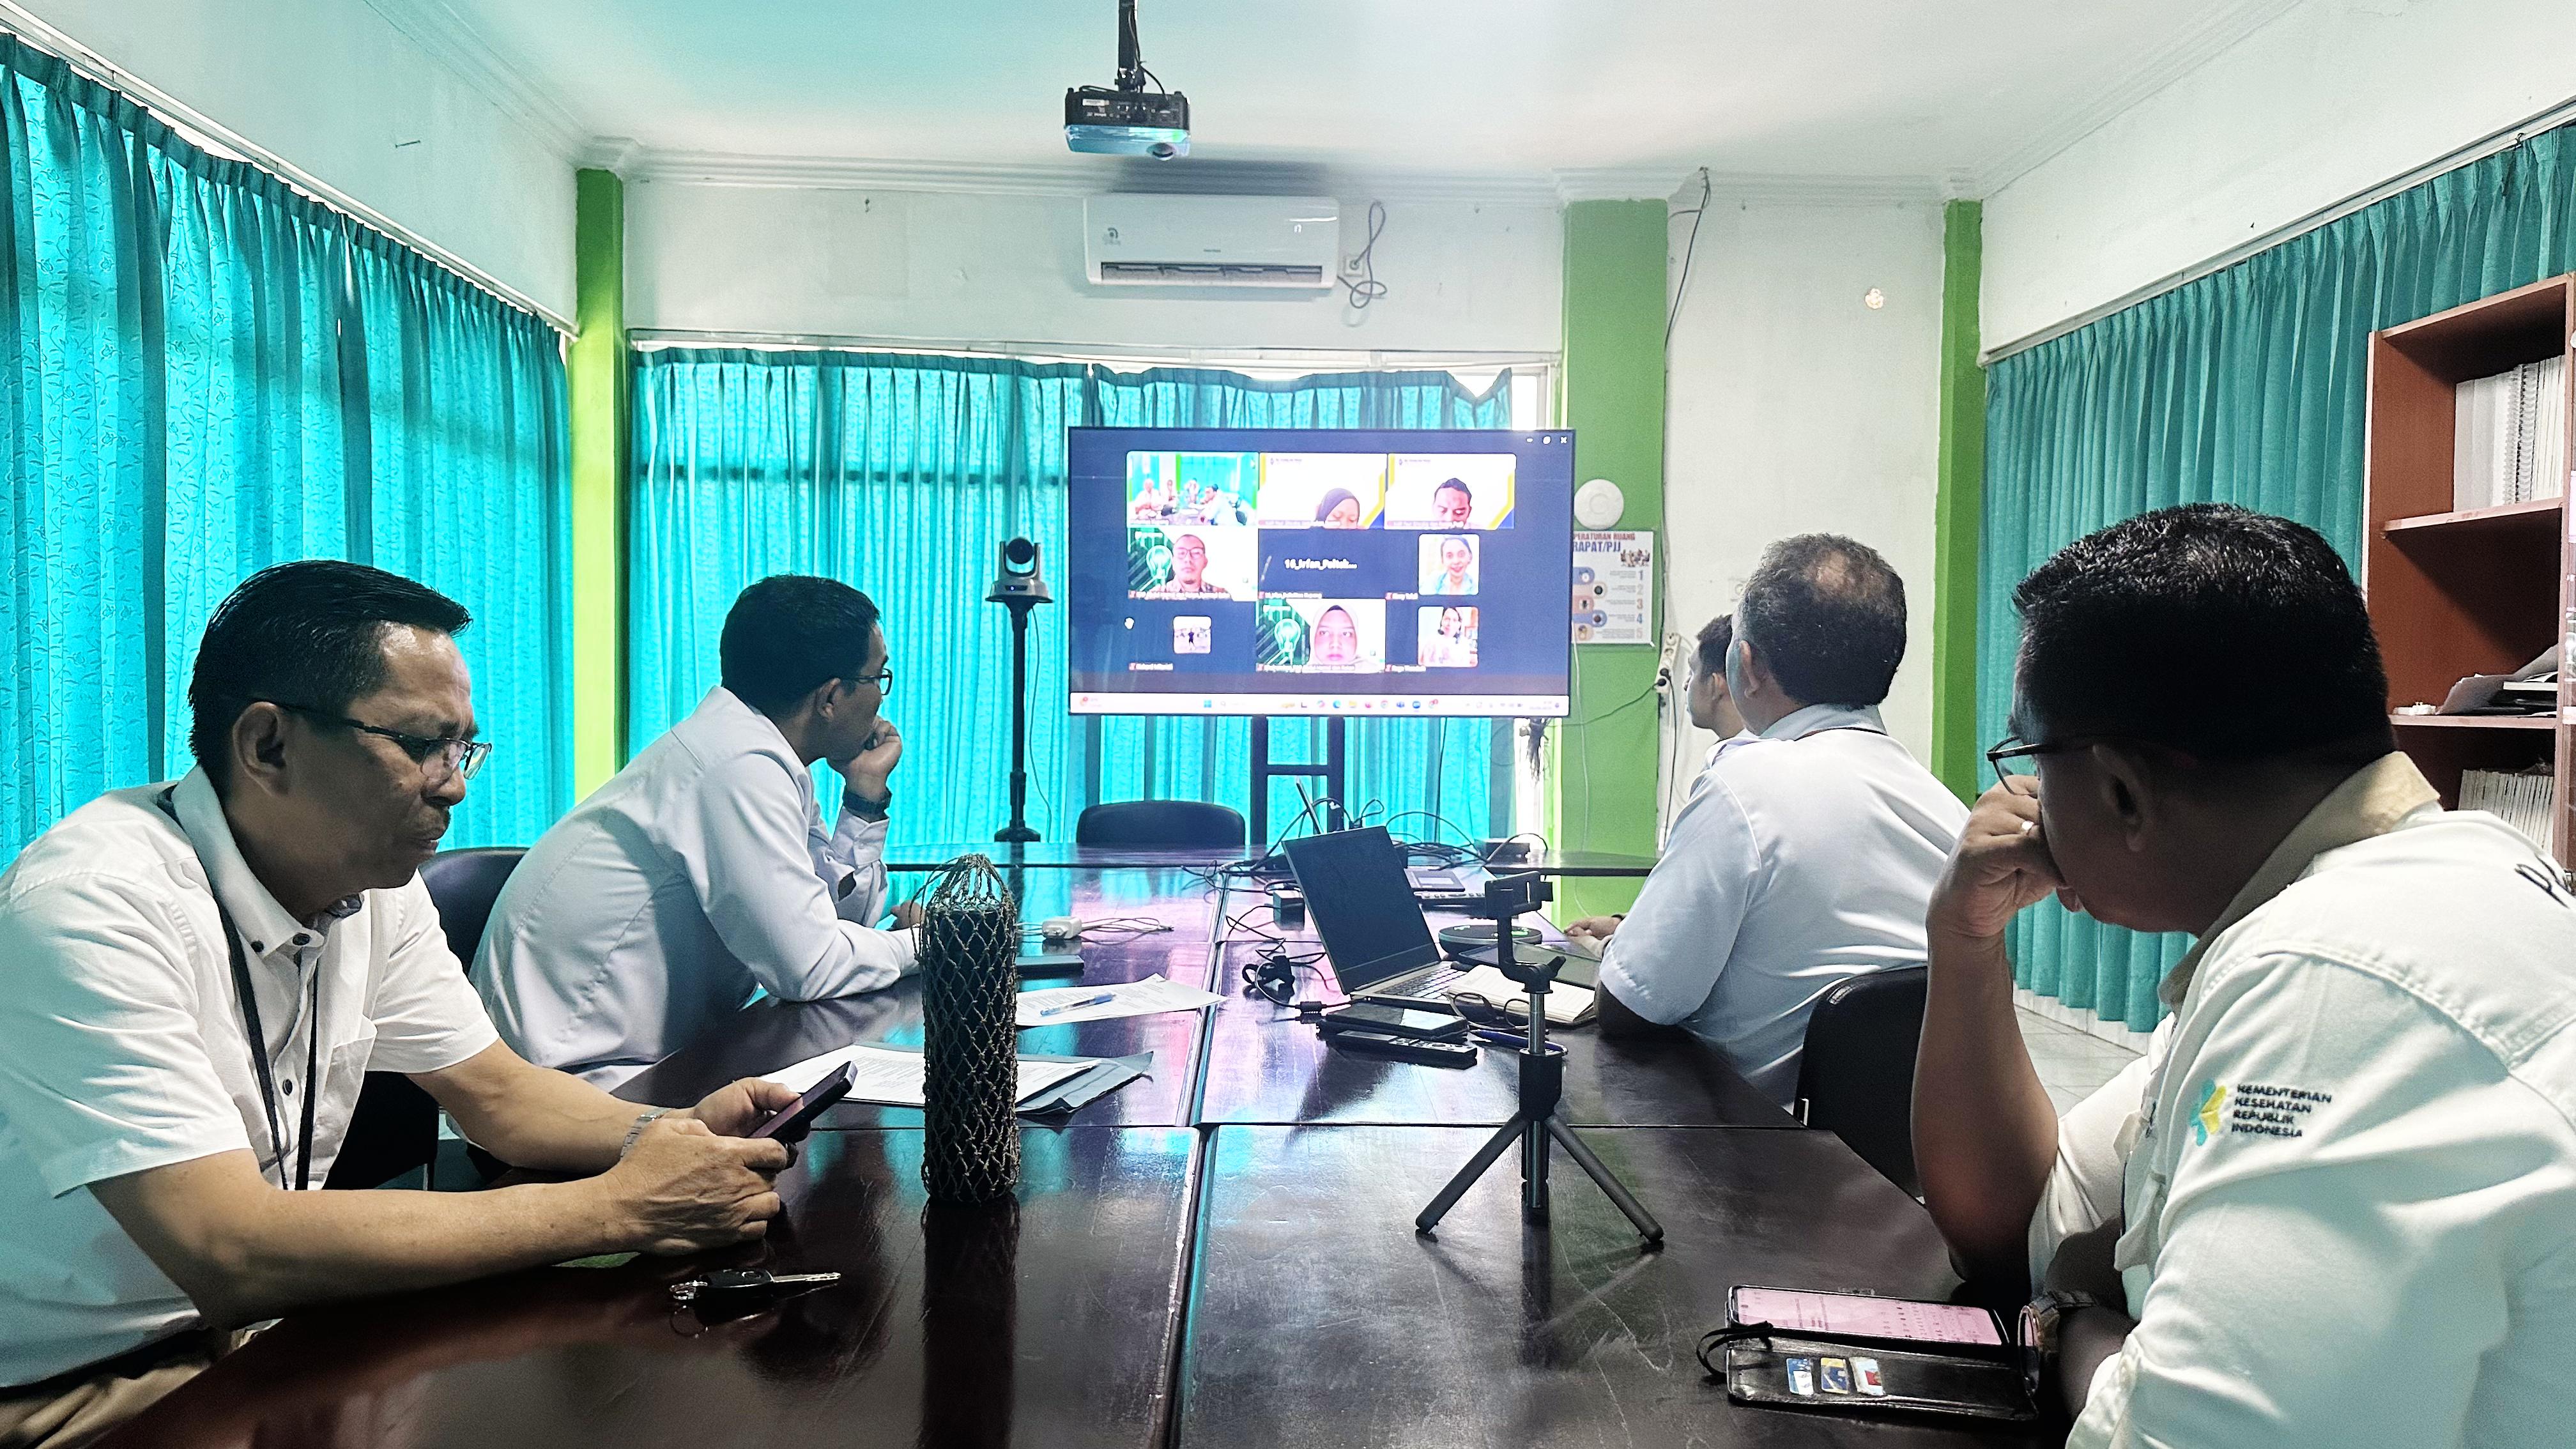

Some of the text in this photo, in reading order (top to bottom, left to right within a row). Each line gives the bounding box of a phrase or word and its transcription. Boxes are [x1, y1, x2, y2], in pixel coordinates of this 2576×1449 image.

[1636, 613, 1643, 624] 4
[2237, 1084, 2332, 1103] KEMENTERIAN
[2235, 1096, 2312, 1114] KESEHATAN
[2233, 1110, 2294, 1124] REPUBLIK
[2231, 1123, 2303, 1137] INDONESIA
